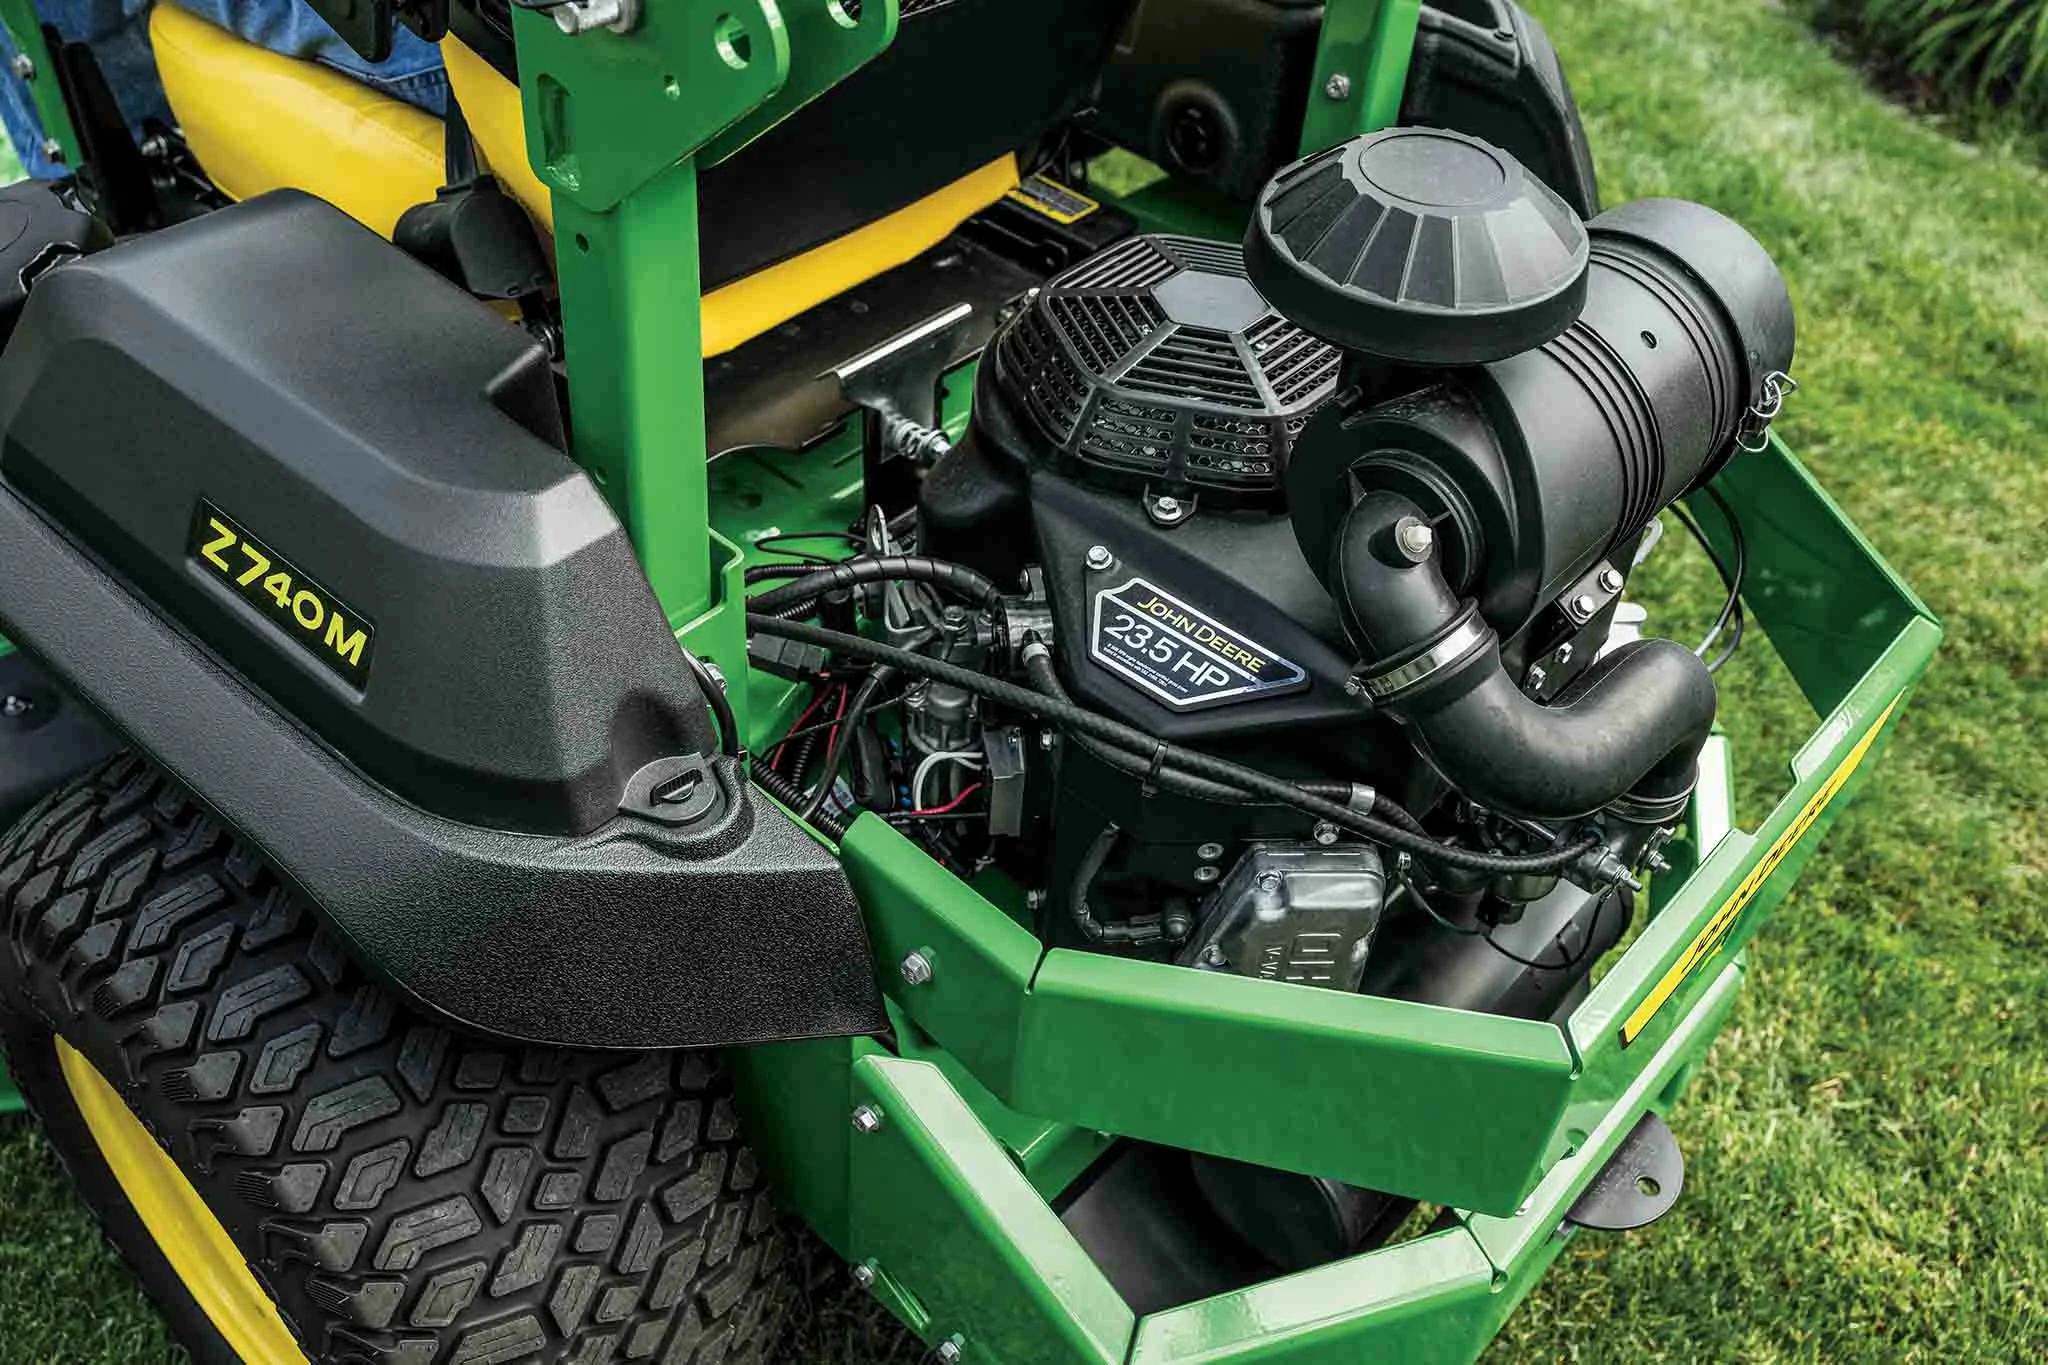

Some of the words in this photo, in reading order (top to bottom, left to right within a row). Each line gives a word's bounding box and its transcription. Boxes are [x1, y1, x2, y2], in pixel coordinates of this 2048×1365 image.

[201, 516, 367, 667] Z740M
[1103, 614, 1180, 663] 23.5
[1171, 650, 1231, 687] HP
[1136, 596, 1197, 633] JOHN
[1193, 624, 1267, 673] DEERE
